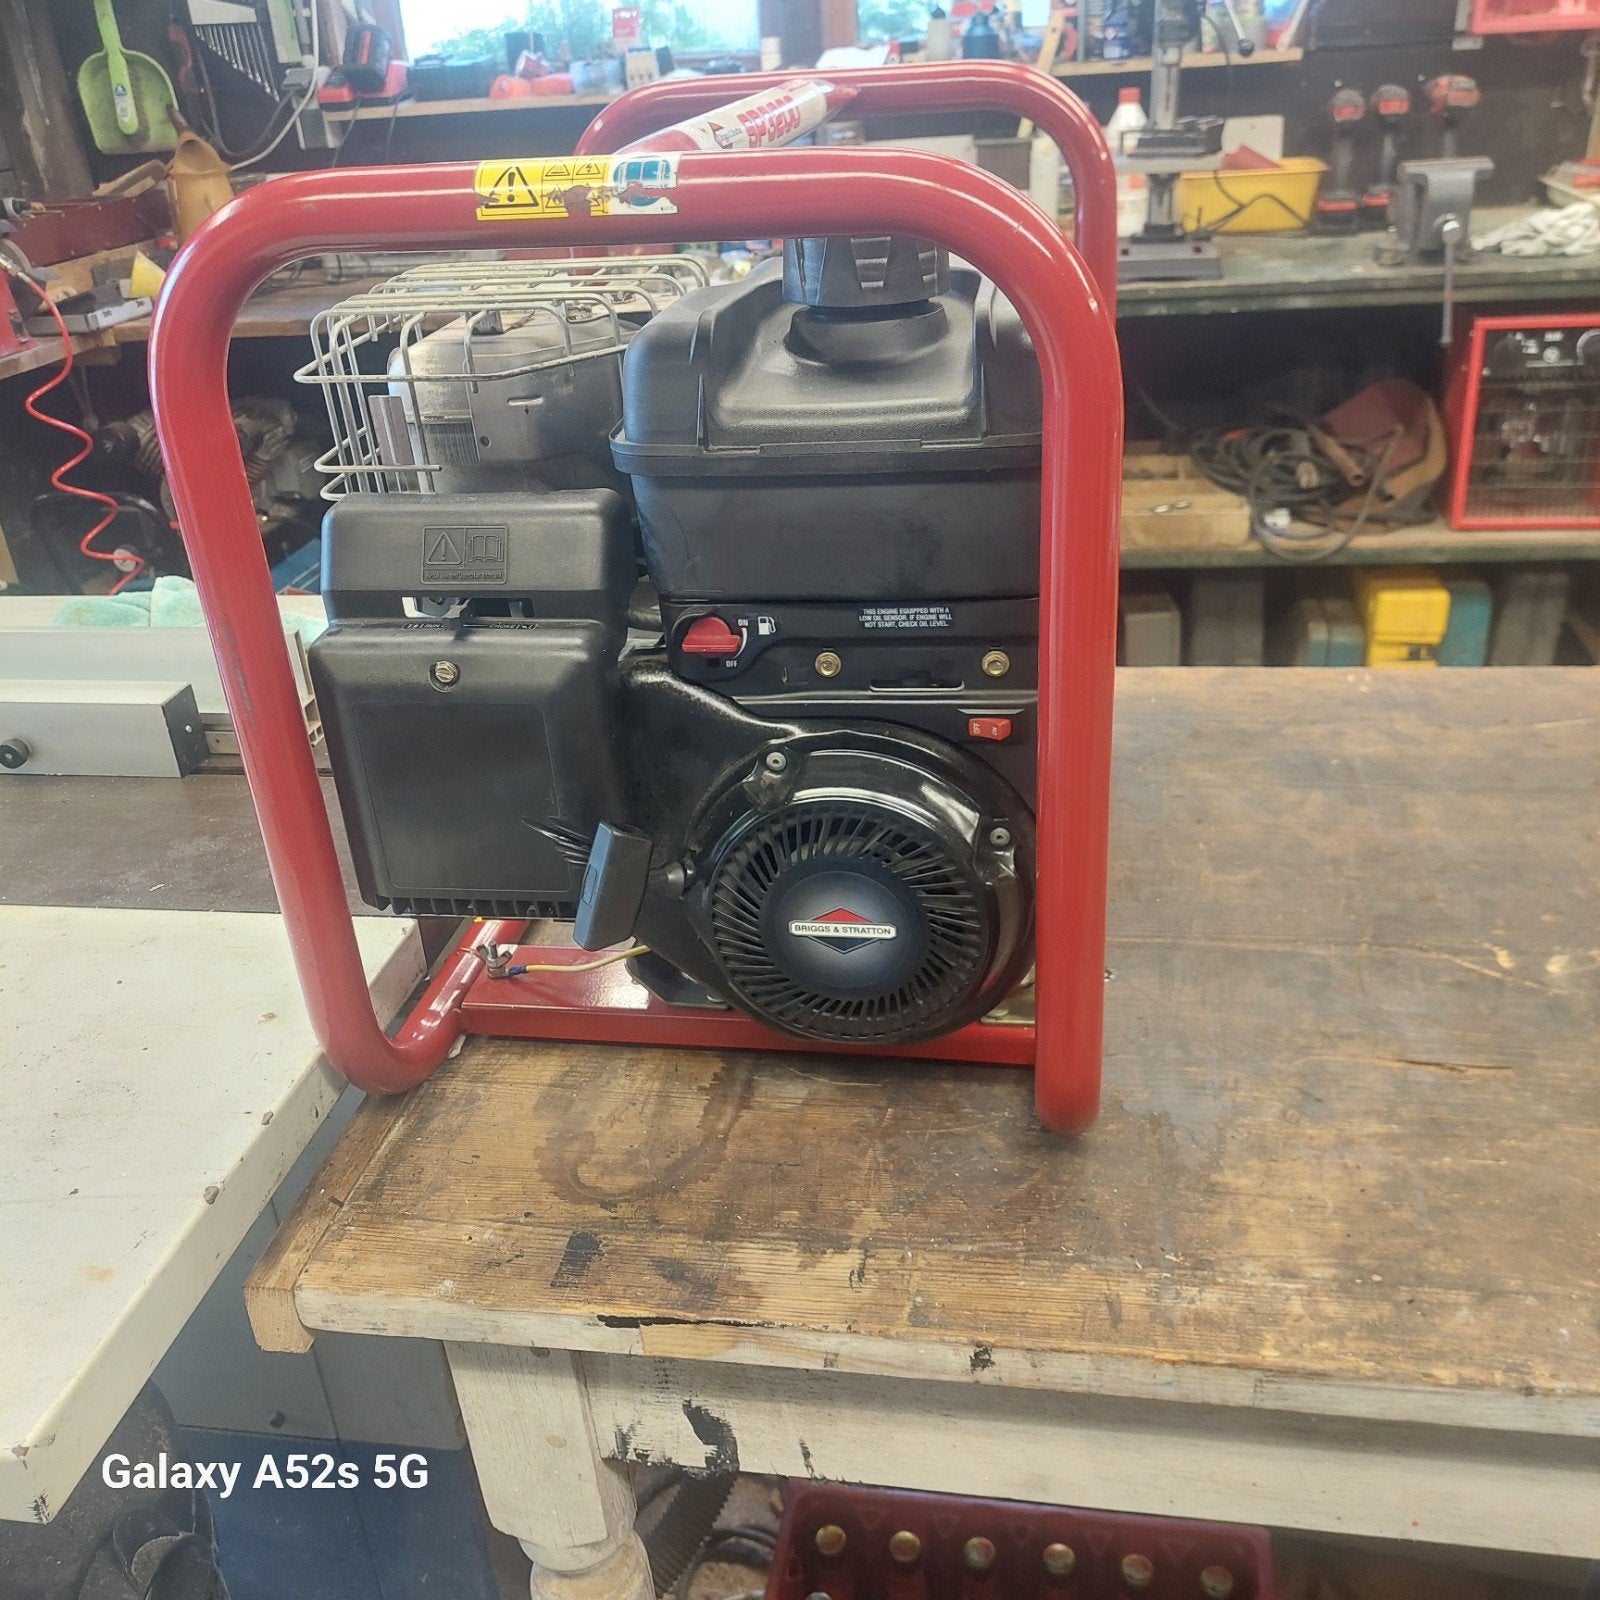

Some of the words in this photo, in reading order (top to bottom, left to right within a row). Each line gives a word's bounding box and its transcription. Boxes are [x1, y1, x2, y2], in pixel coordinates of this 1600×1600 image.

[929, 606, 944, 614] WITH
[738, 619, 748, 627] ON
[898, 620, 918, 628] CHECK
[726, 660, 738, 668] OFF
[972, 722, 981, 734] OFF
[794, 924, 831, 933] BRIGGS
[842, 926, 891, 935] STRATTON
